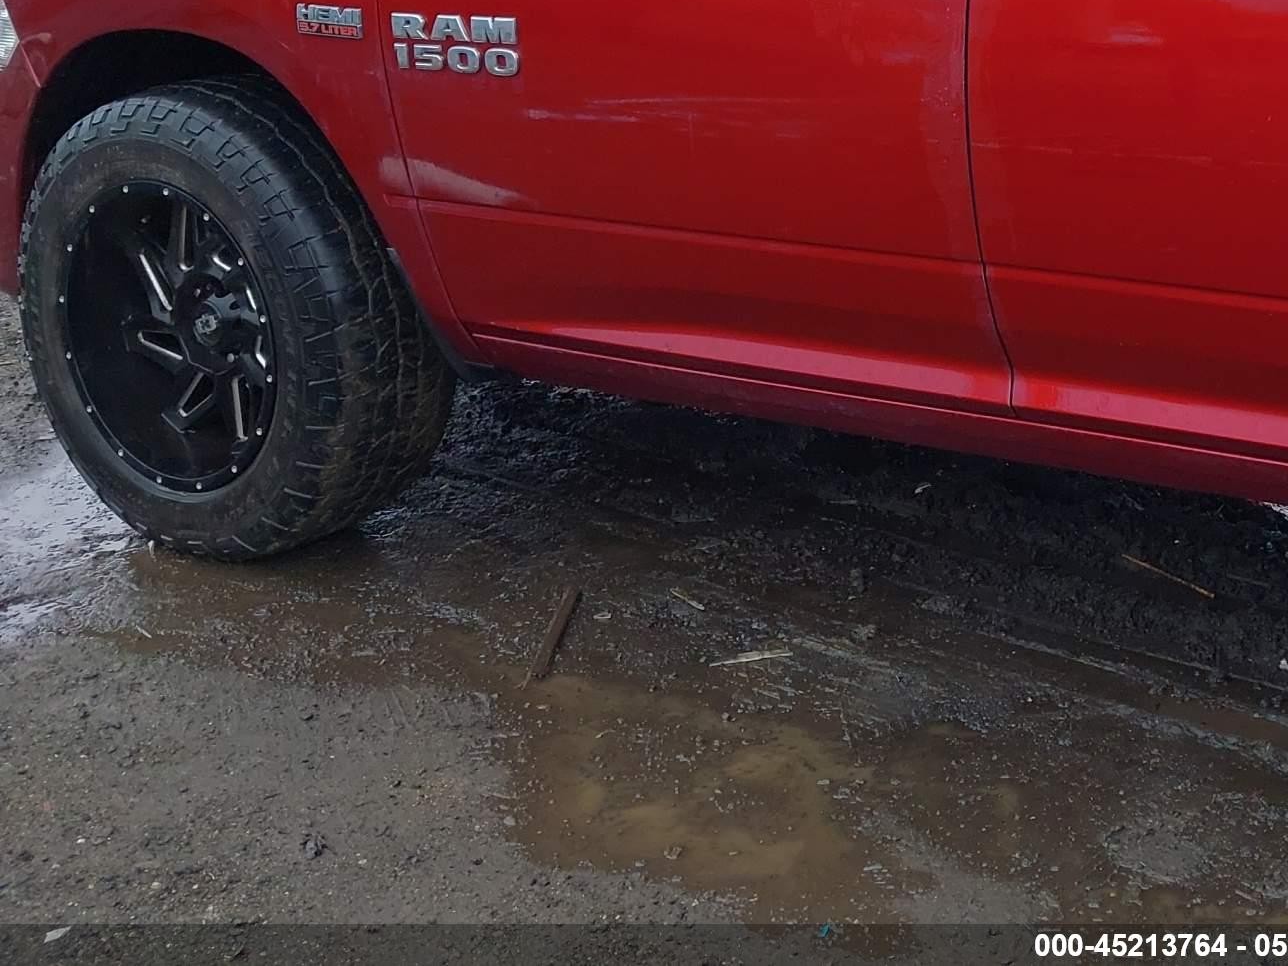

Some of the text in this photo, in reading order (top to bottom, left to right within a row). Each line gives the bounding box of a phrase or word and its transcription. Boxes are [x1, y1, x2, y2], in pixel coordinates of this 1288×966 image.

[296, 3, 362, 26] HEMI
[391, 12, 517, 44] RAM
[321, 24, 358, 37] LITER
[394, 43, 518, 76] 1500
